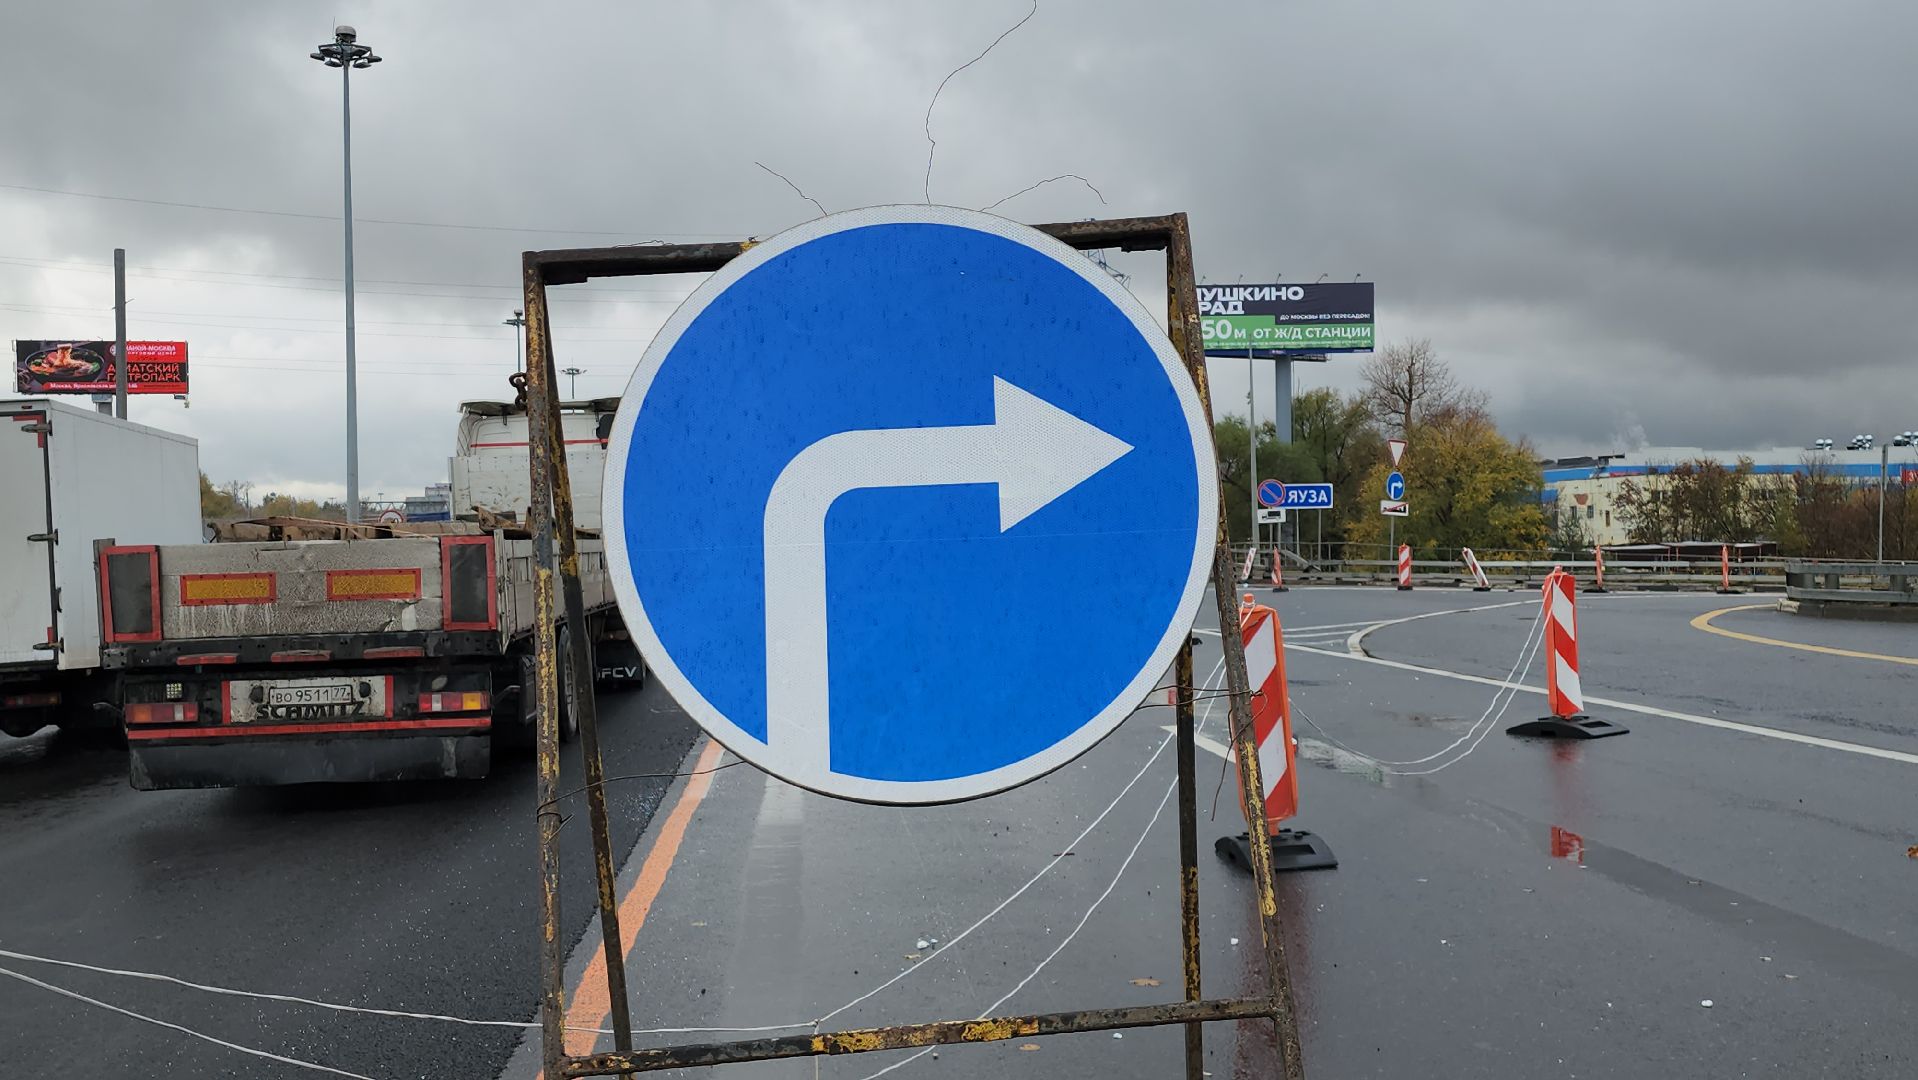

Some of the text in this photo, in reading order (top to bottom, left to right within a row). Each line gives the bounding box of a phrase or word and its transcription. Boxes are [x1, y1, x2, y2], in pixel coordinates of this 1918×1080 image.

[1199, 301, 1245, 315] РАД
[1201, 319, 1232, 340] 50
[1254, 328, 1272, 339] ОТ
[1275, 327, 1303, 340] Ж/Д
[1305, 327, 1371, 339] СТАНЦИИ
[1288, 489, 1328, 503] ЯУЗА
